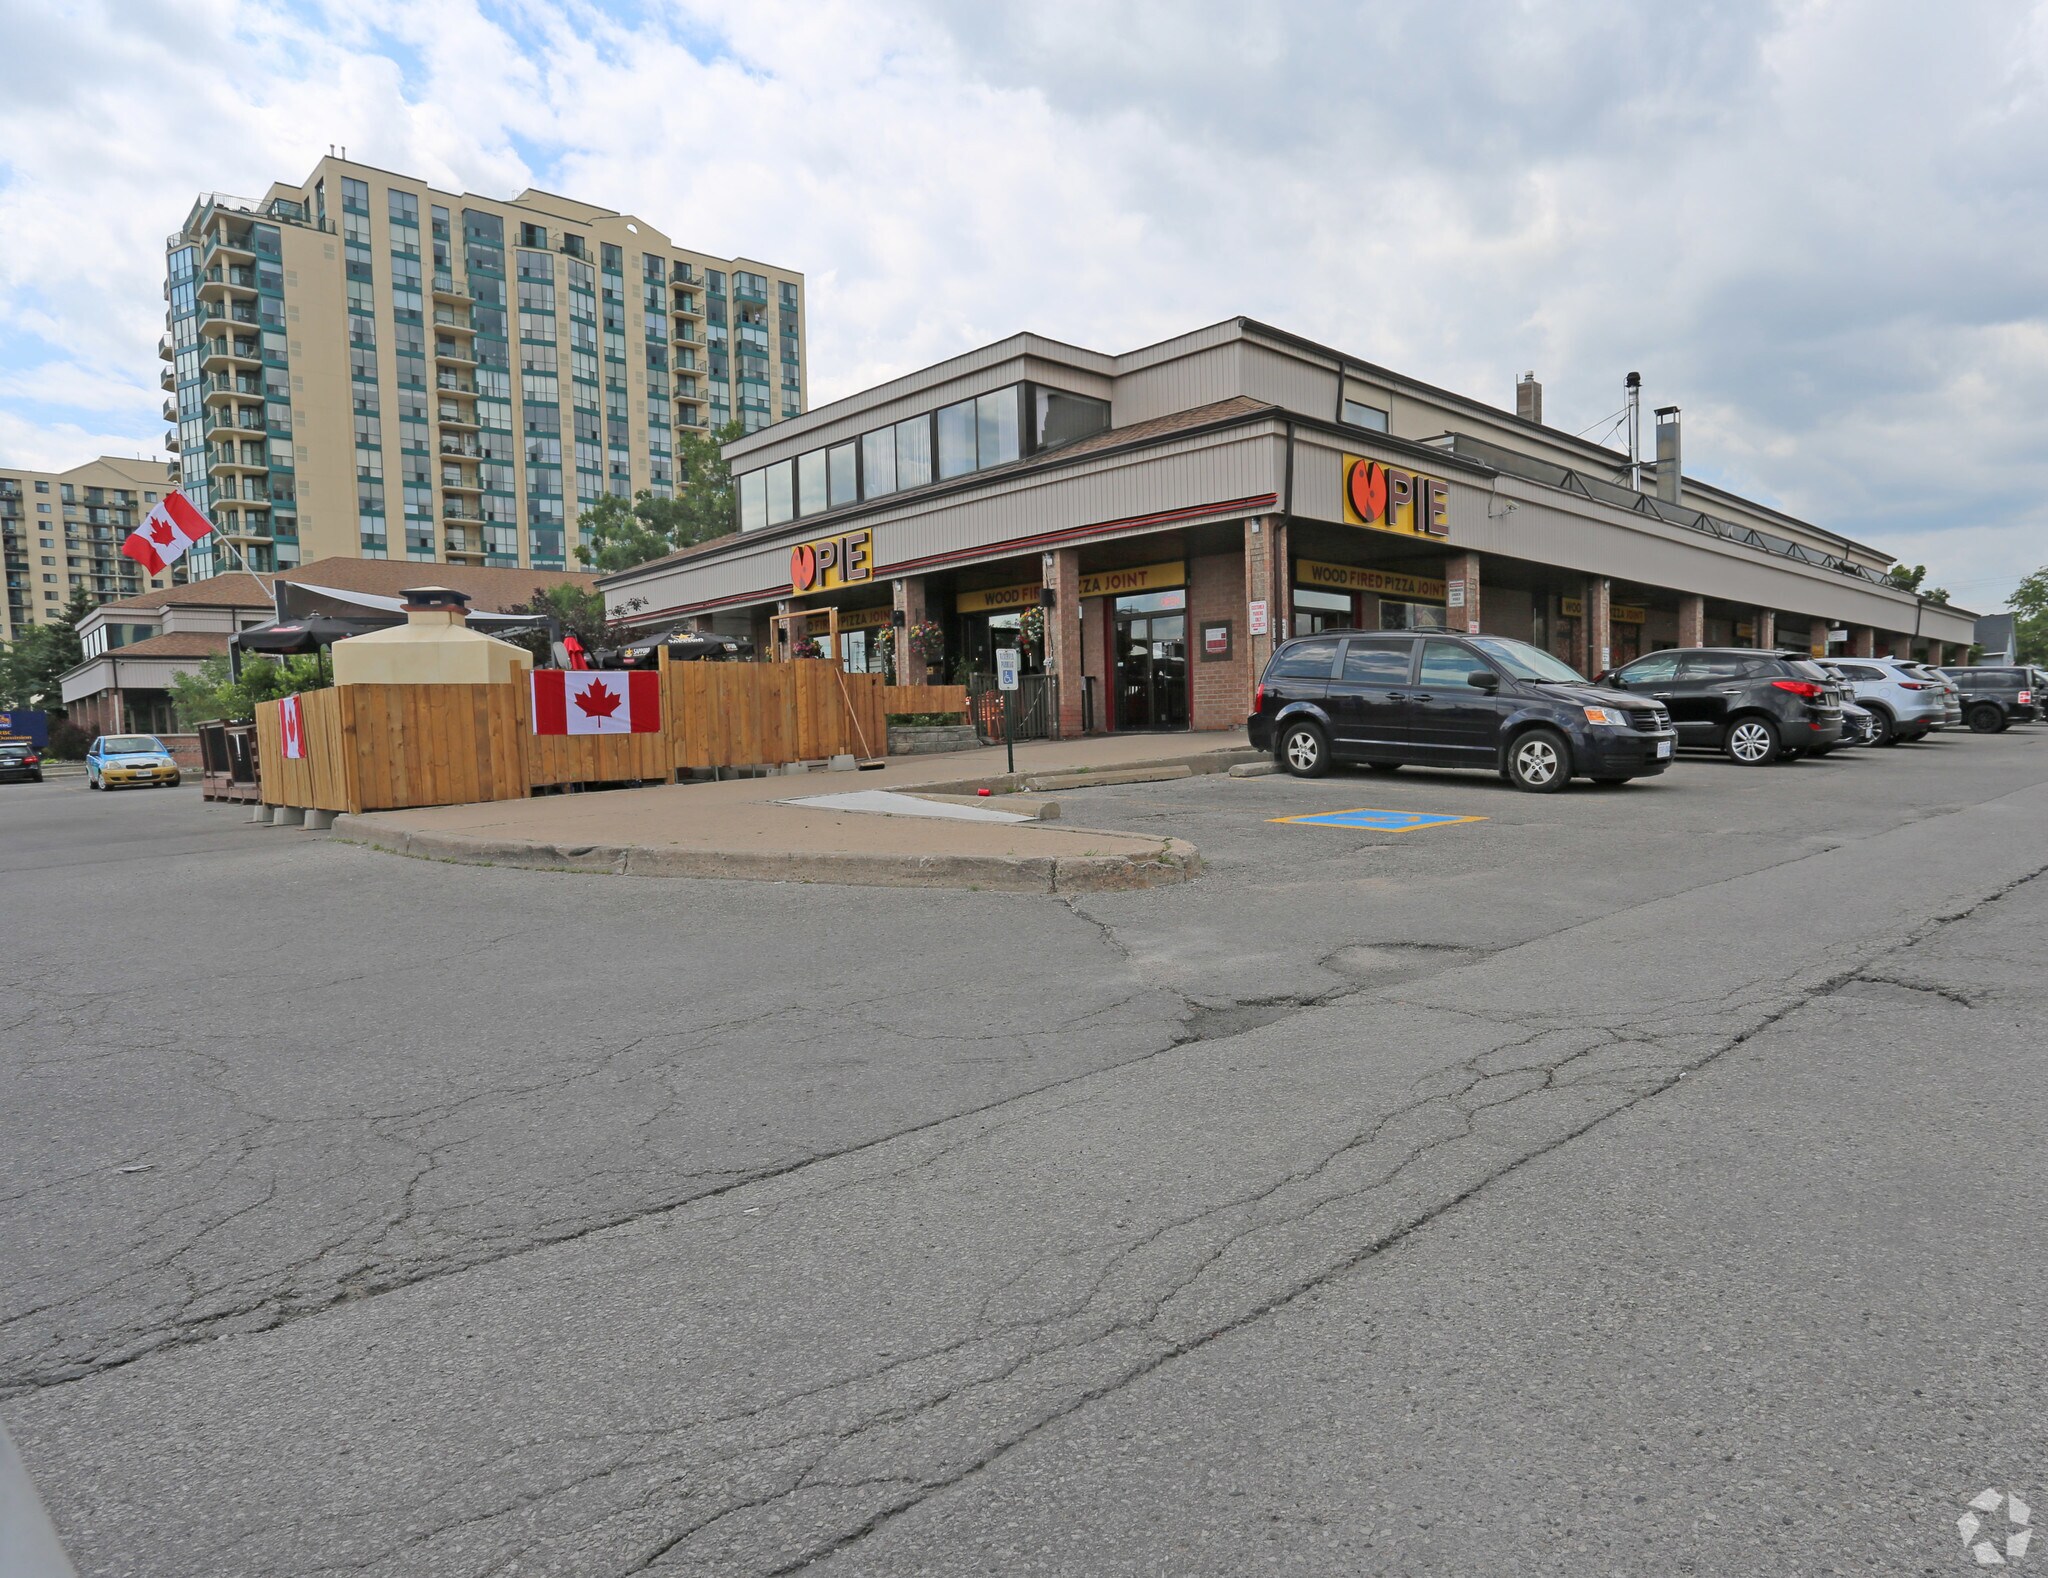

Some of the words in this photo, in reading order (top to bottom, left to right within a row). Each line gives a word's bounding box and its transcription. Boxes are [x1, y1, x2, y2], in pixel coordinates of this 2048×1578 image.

[1384, 468, 1449, 536] PIE
[815, 532, 869, 587] PIE
[1105, 570, 1148, 590] JOINT
[1312, 566, 1347, 583] WOOD
[1350, 571, 1382, 588] FIRED
[1385, 578, 1414, 592] PIZZA
[1417, 581, 1446, 598] JOINT
[985, 590, 1019, 606] WOOD
[1022, 585, 1042, 601] FIR
[1565, 601, 1581, 613] WOO
[840, 613, 867, 627] PIZZA
